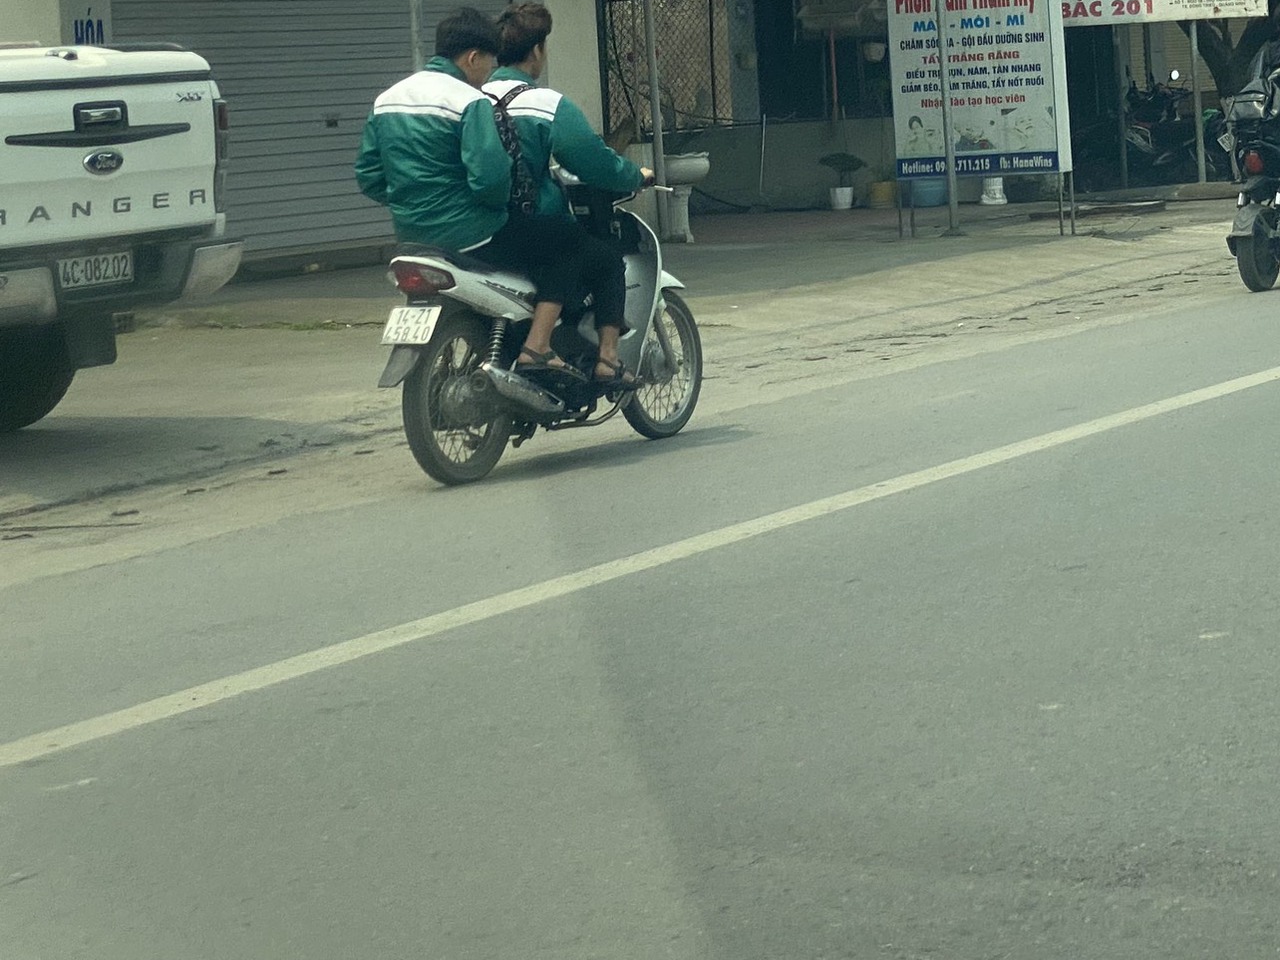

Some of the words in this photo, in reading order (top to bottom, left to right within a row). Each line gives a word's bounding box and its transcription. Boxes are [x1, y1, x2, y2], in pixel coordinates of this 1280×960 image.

[913, 17, 937, 33] MÀ
[961, 14, 990, 29] MÔI
[1006, 11, 1025, 27] MÍ
[1025, 31, 1045, 43] SINH
[948, 68, 965, 79] ỤN,
[1011, 63, 1042, 73] NHANG
[967, 95, 983, 107] tạo
[985, 95, 1003, 106] học
[1005, 92, 1026, 103] viên
[95, 152, 118, 170] Ford
[902, 161, 934, 175] Hotline:
[935, 158, 990, 173] 09.711.215
[1012, 155, 1053, 169] HanaWins
[0, 188, 207, 226] RANGER
